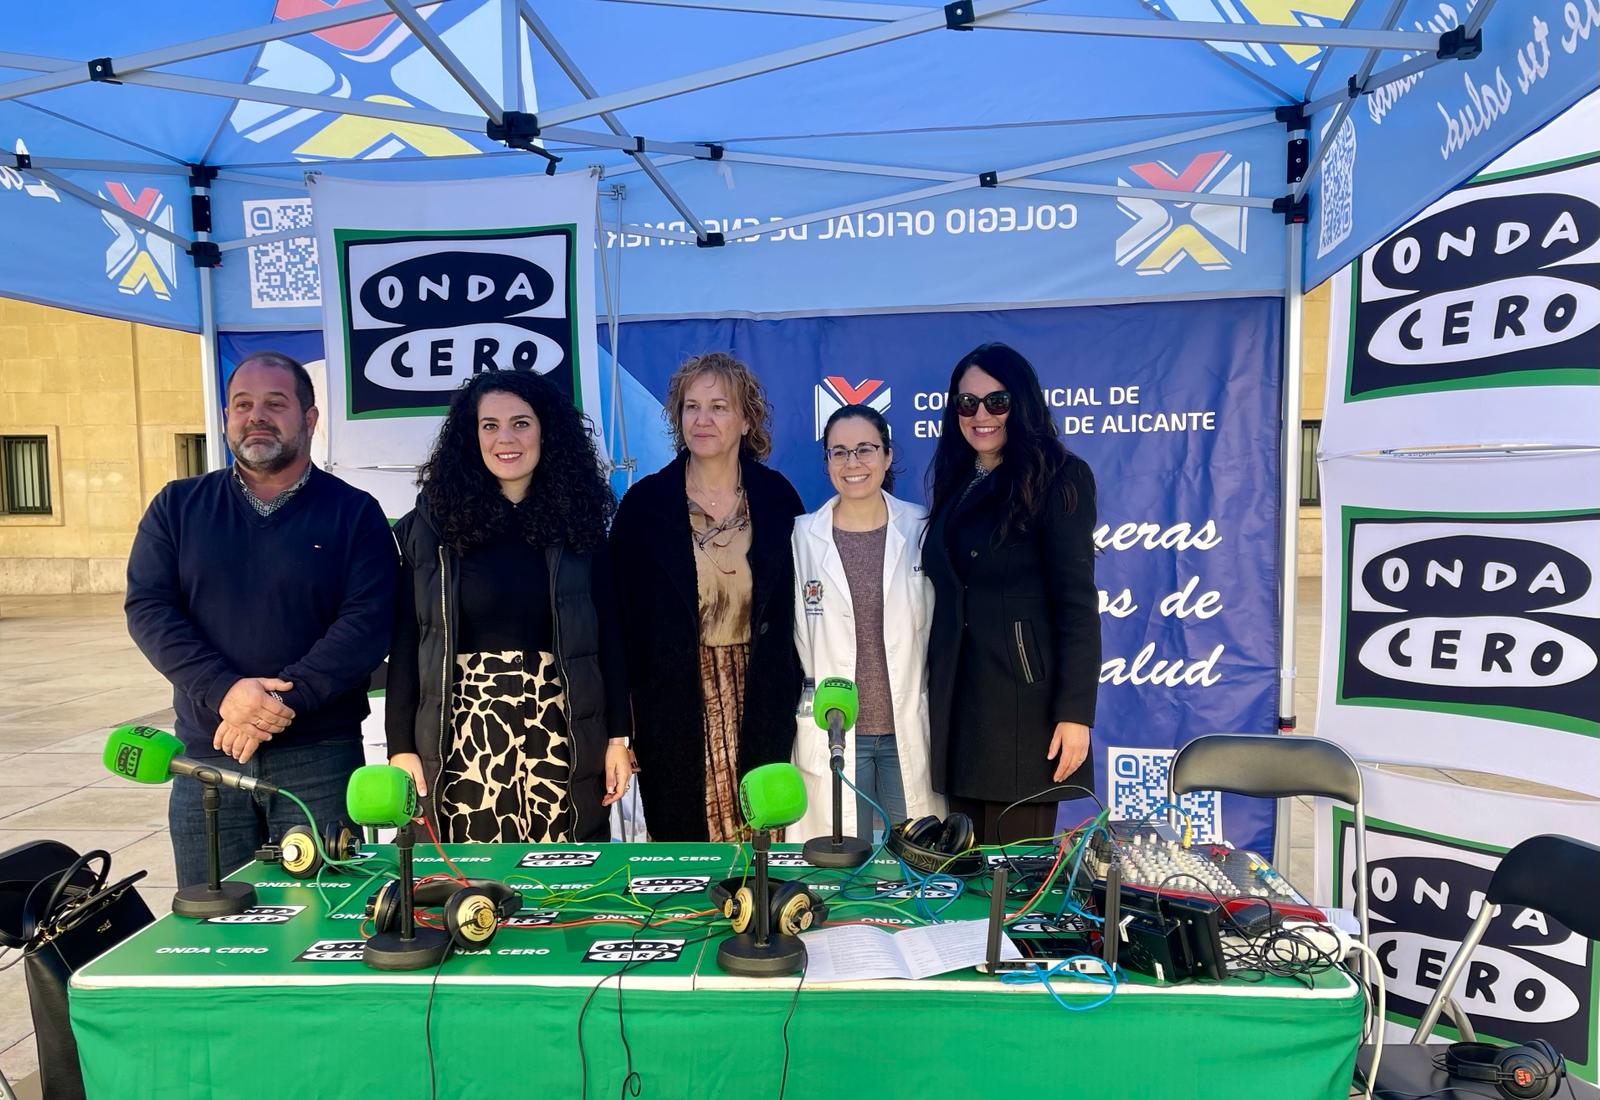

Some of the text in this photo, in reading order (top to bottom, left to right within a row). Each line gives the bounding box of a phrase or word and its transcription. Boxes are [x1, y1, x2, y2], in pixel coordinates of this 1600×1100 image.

[1391, 211, 1580, 274] ONDA
[378, 272, 535, 302] ONDA
[1398, 292, 1577, 351] CERO
[391, 339, 538, 378] CERO
[1042, 386, 1140, 407] ICIAL DE
[1065, 412, 1216, 435] DE ALICANTE
[1160, 576, 1223, 619] de
[1381, 556, 1567, 596] ONDA
[1098, 643, 1225, 688] alud
[1388, 627, 1564, 677] CERO
[1375, 939, 1547, 1012] CERO
